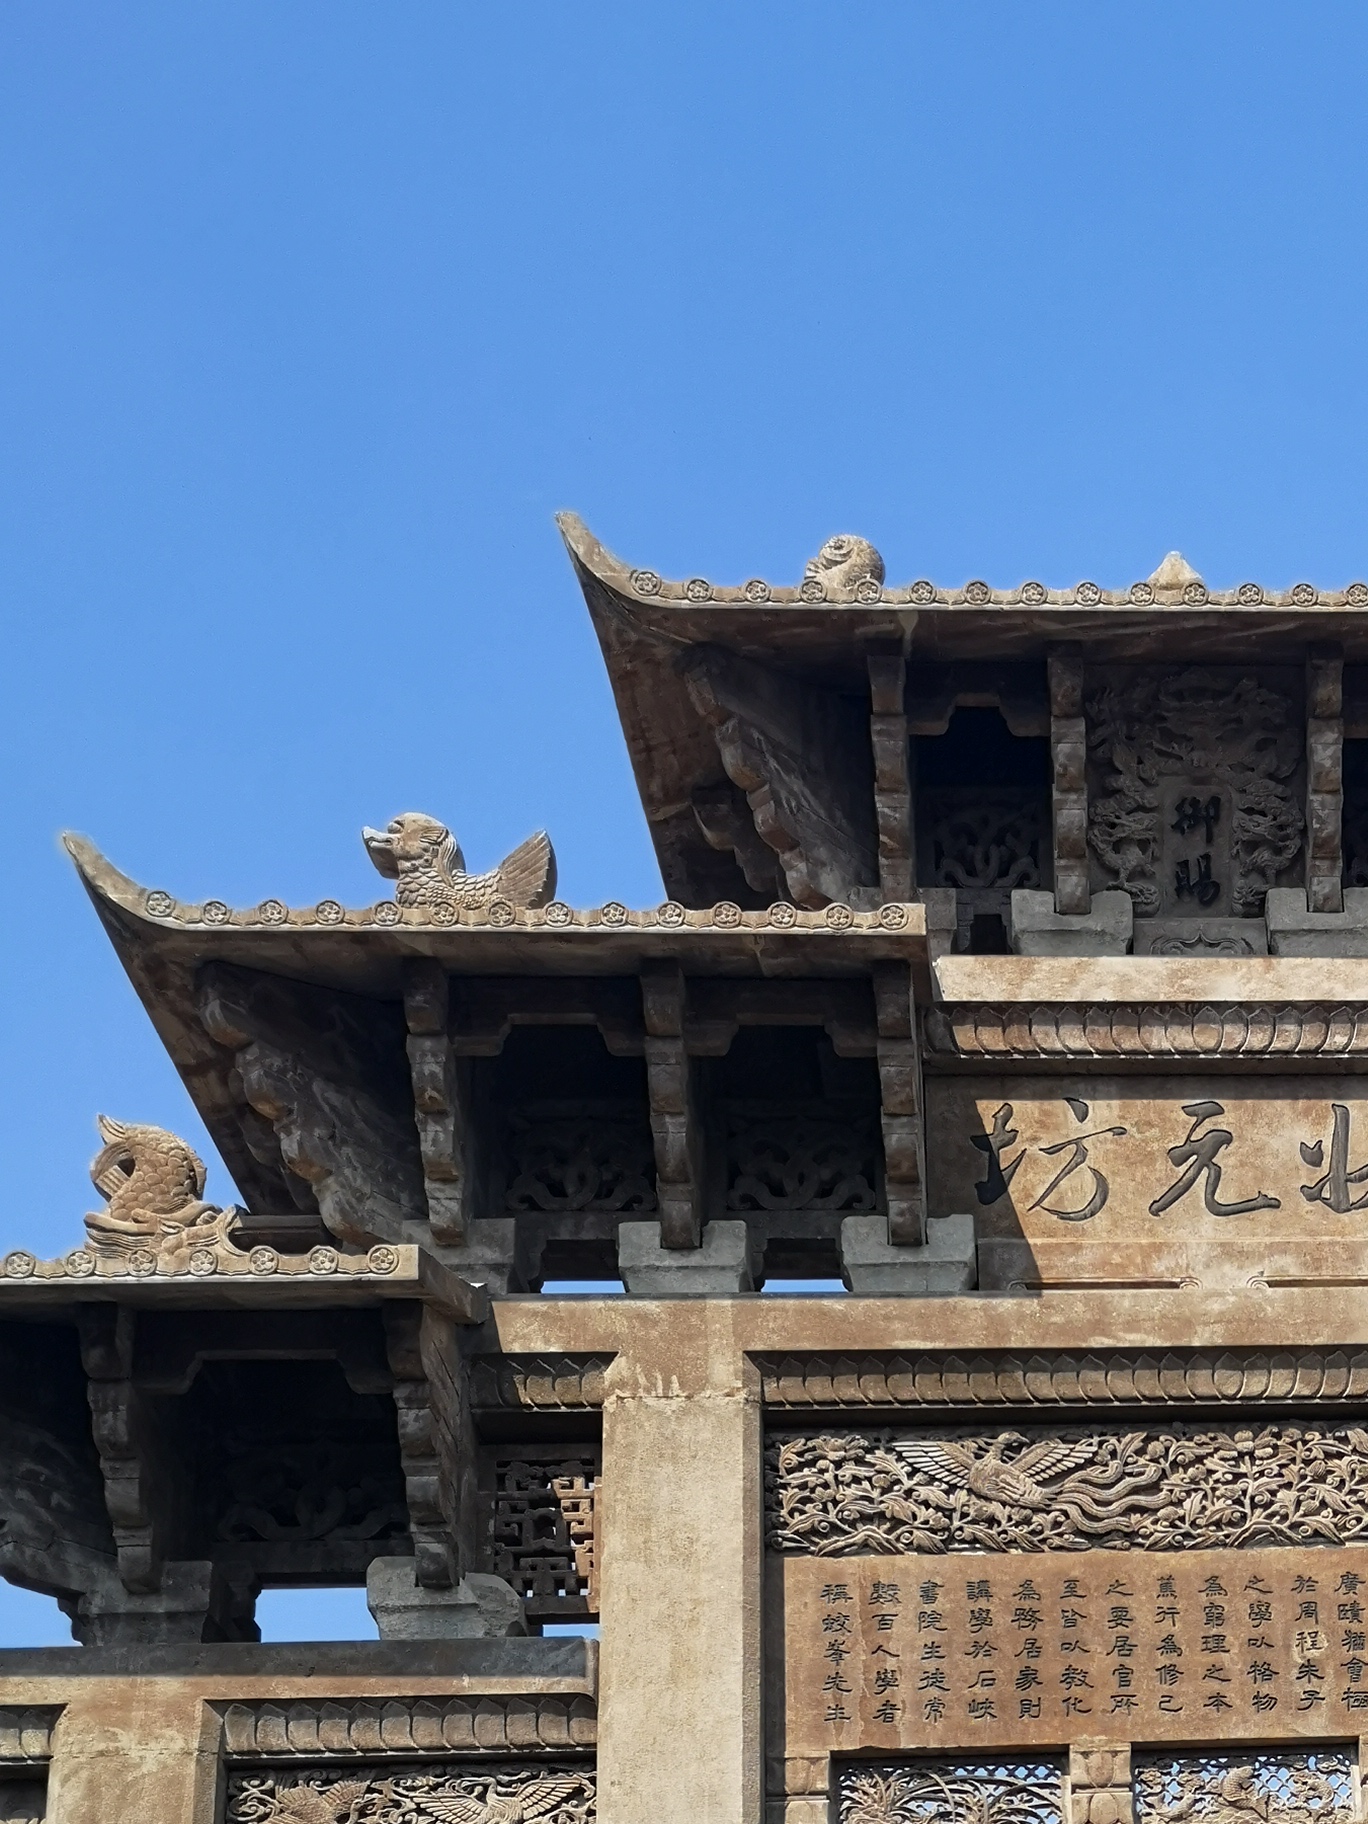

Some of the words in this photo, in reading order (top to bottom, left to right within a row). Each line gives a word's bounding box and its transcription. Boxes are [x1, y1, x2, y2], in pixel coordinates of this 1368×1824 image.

[918, 1580, 951, 1723] 書院生徒常
